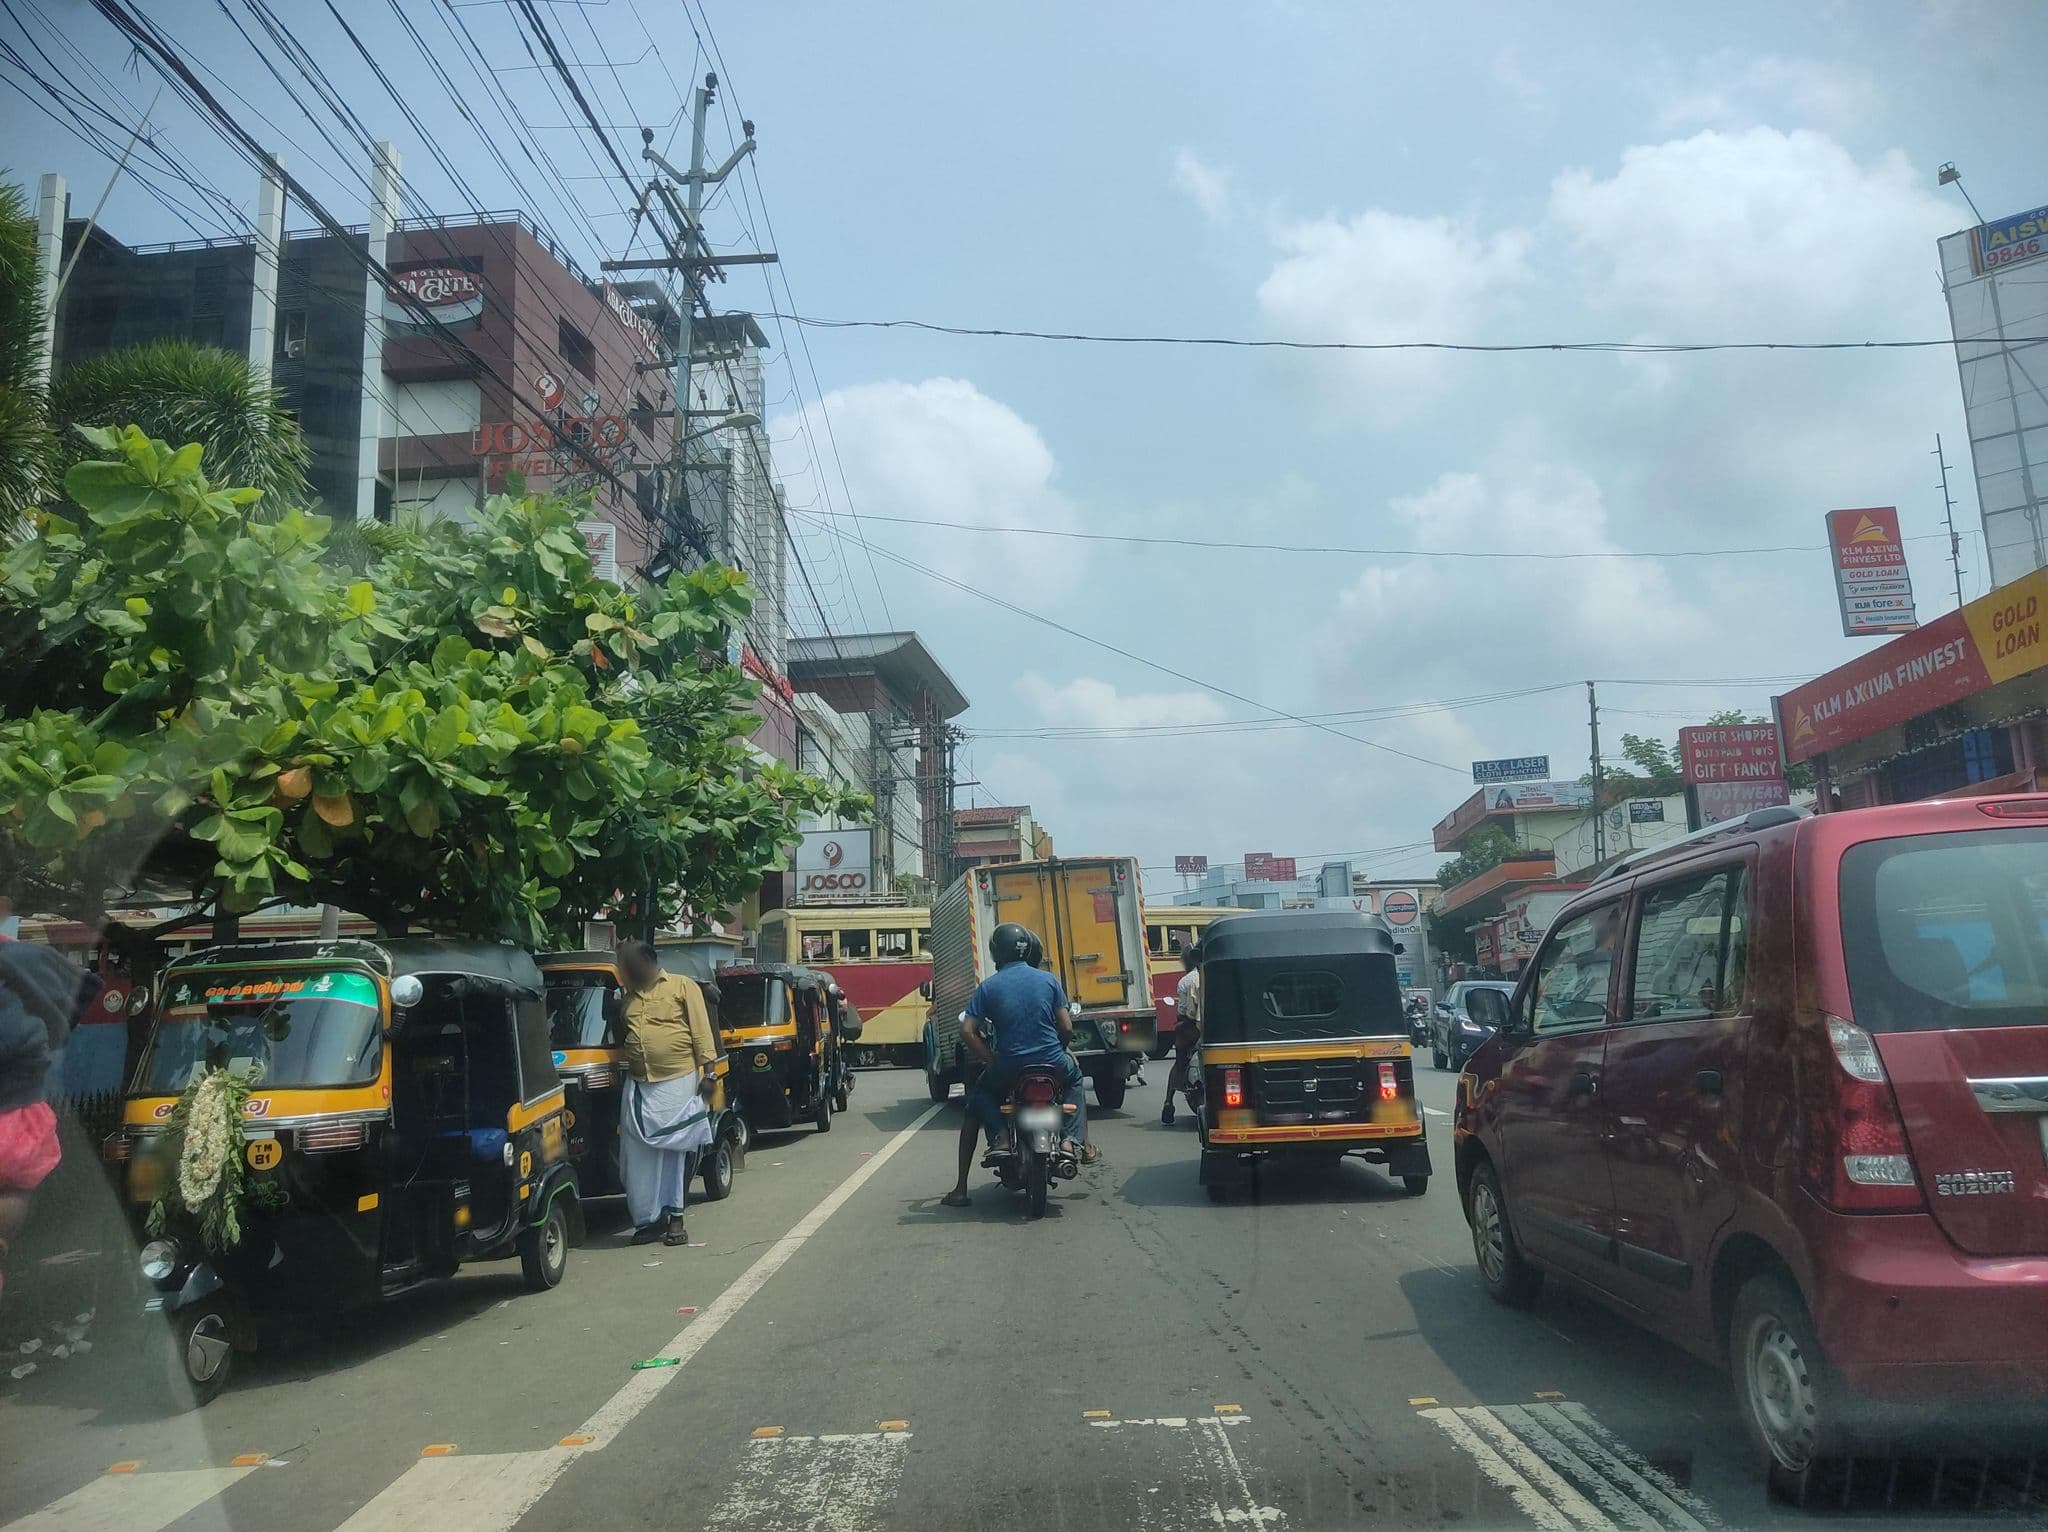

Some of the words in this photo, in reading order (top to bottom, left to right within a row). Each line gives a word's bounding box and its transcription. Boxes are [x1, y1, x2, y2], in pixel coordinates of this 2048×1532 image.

[1987, 239, 2040, 266] 9846
[410, 268, 453, 277] HOTEL
[471, 415, 626, 456] JOSCO
[1841, 546, 1863, 556] KLM
[1843, 555, 1881, 564] FINVEST
[1884, 553, 1901, 562] LTD
[1849, 570, 1874, 579] GOLD
[1876, 568, 1900, 577] LOAN
[1992, 596, 2038, 634] GOLD
[1996, 624, 2040, 660] LOAN
[1813, 693, 1842, 723] KLM
[1896, 637, 1967, 687] FINVEST
[1691, 731, 1727, 744] SUPER
[1730, 728, 1775, 741] SHOPPE
[1474, 762, 1500, 773] FLEX
[1510, 757, 1546, 769] LASER
[1694, 763, 1726, 779] GIFT
[1734, 760, 1777, 777] FANCY
[801, 873, 866, 892] JOSCO
[1935, 1171, 2014, 1184] MARUTI
[1938, 1181, 2015, 1196] SUZUKI
